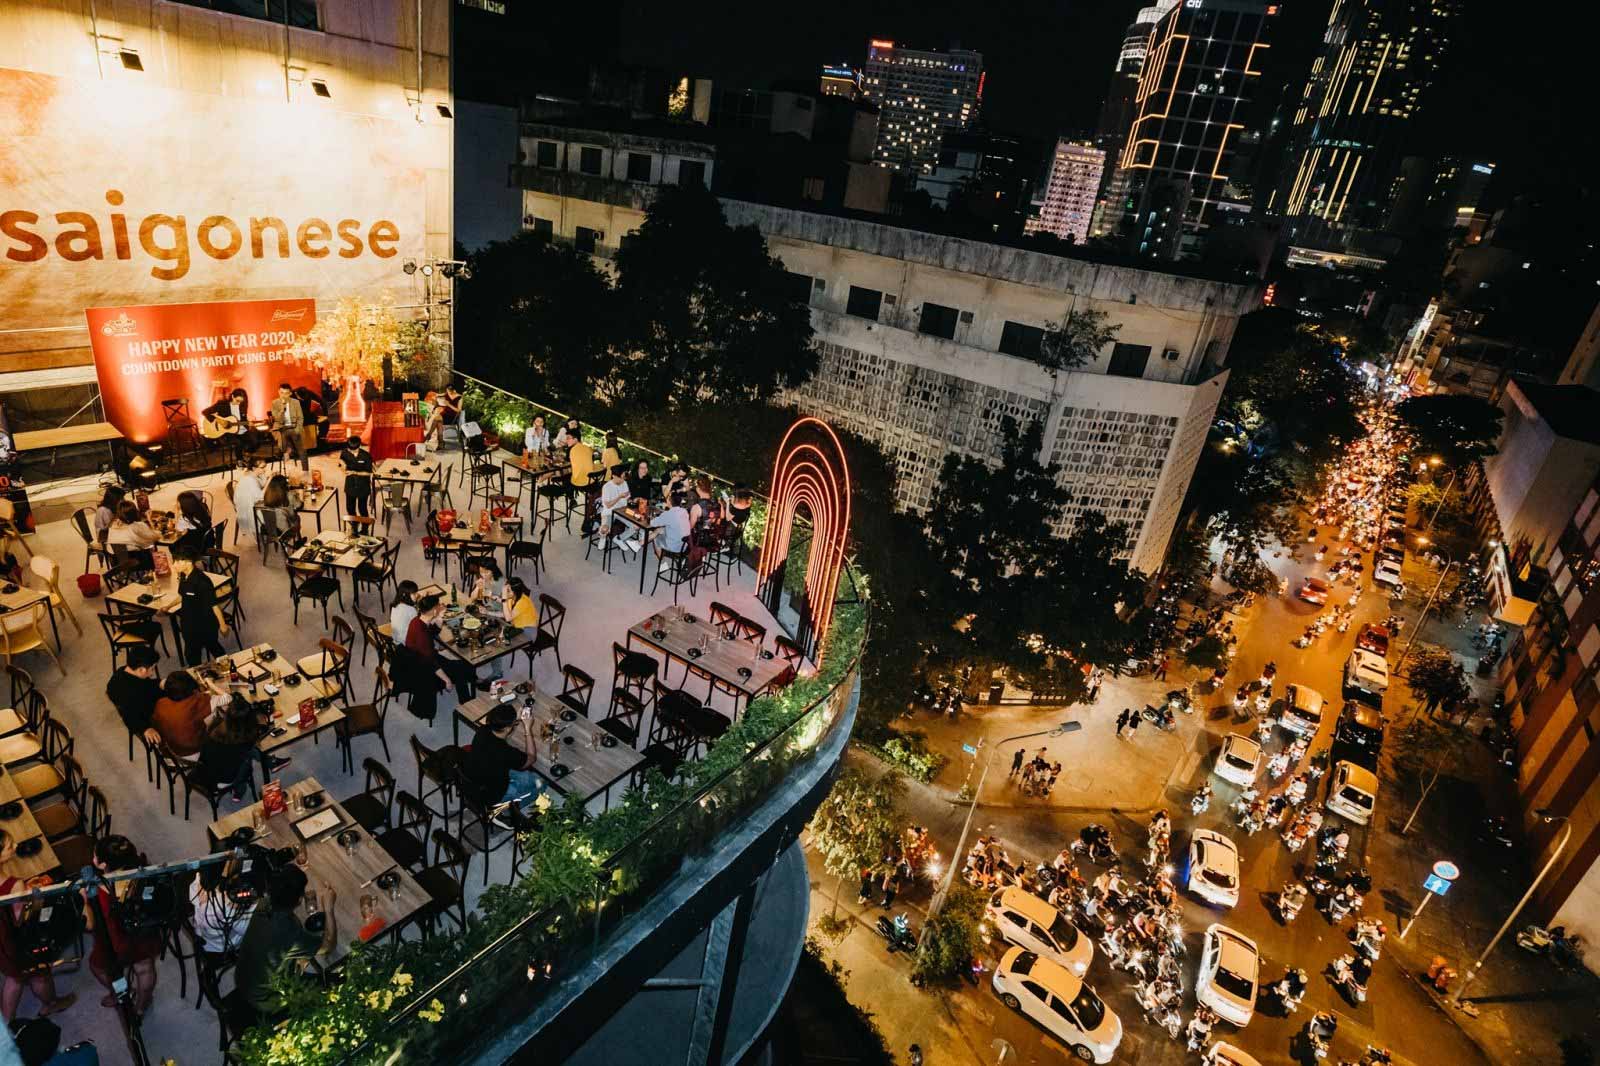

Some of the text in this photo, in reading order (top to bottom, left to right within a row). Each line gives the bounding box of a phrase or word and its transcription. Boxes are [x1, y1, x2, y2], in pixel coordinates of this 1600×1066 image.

[0, 189, 400, 281] saigonese
[129, 331, 295, 357] HAPPY NEW YEAR 2020
[122, 359, 199, 375] COUNTDOWN
[201, 354, 235, 368] PARTY
